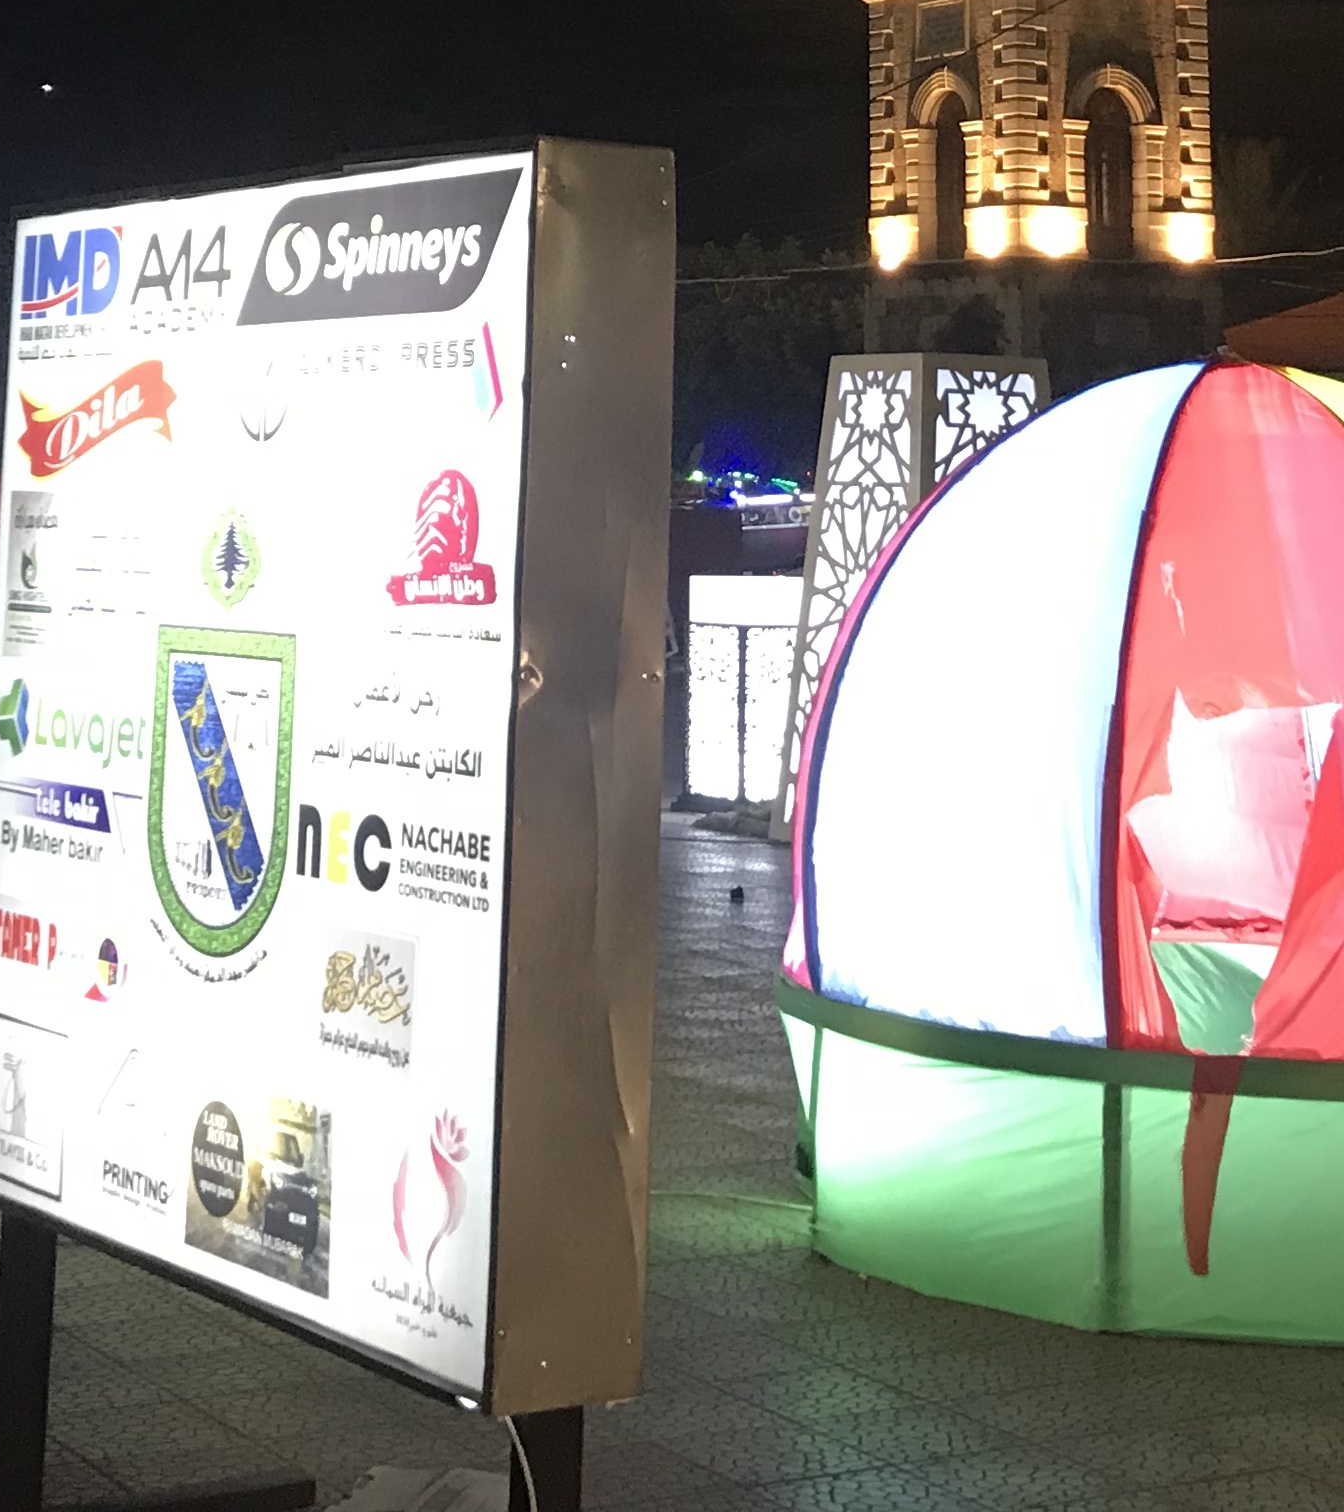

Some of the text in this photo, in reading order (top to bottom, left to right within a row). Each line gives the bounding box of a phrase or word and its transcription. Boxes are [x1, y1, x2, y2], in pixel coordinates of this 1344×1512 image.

[130, 225, 231, 305] A14
[323, 214, 482, 291] Spinneys
[19, 225, 122, 320] IMD
[401, 338, 476, 369] PRESS
[43, 384, 145, 468] Dila
[452, 574, 485, 601] وطن
[34, 696, 146, 769] Lavajet
[425, 747, 483, 782] الكابتن
[1, 820, 20, 853] By
[22, 824, 64, 855] Maher
[401, 822, 491, 863] NACHABE
[399, 858, 489, 890] ENGINEERING &
[397, 882, 490, 913] CONSTRUCTION LTD
[203, 1110, 228, 1130] LAND
[206, 1126, 239, 1151] ROVER
[102, 1159, 170, 1205] PRINTING
